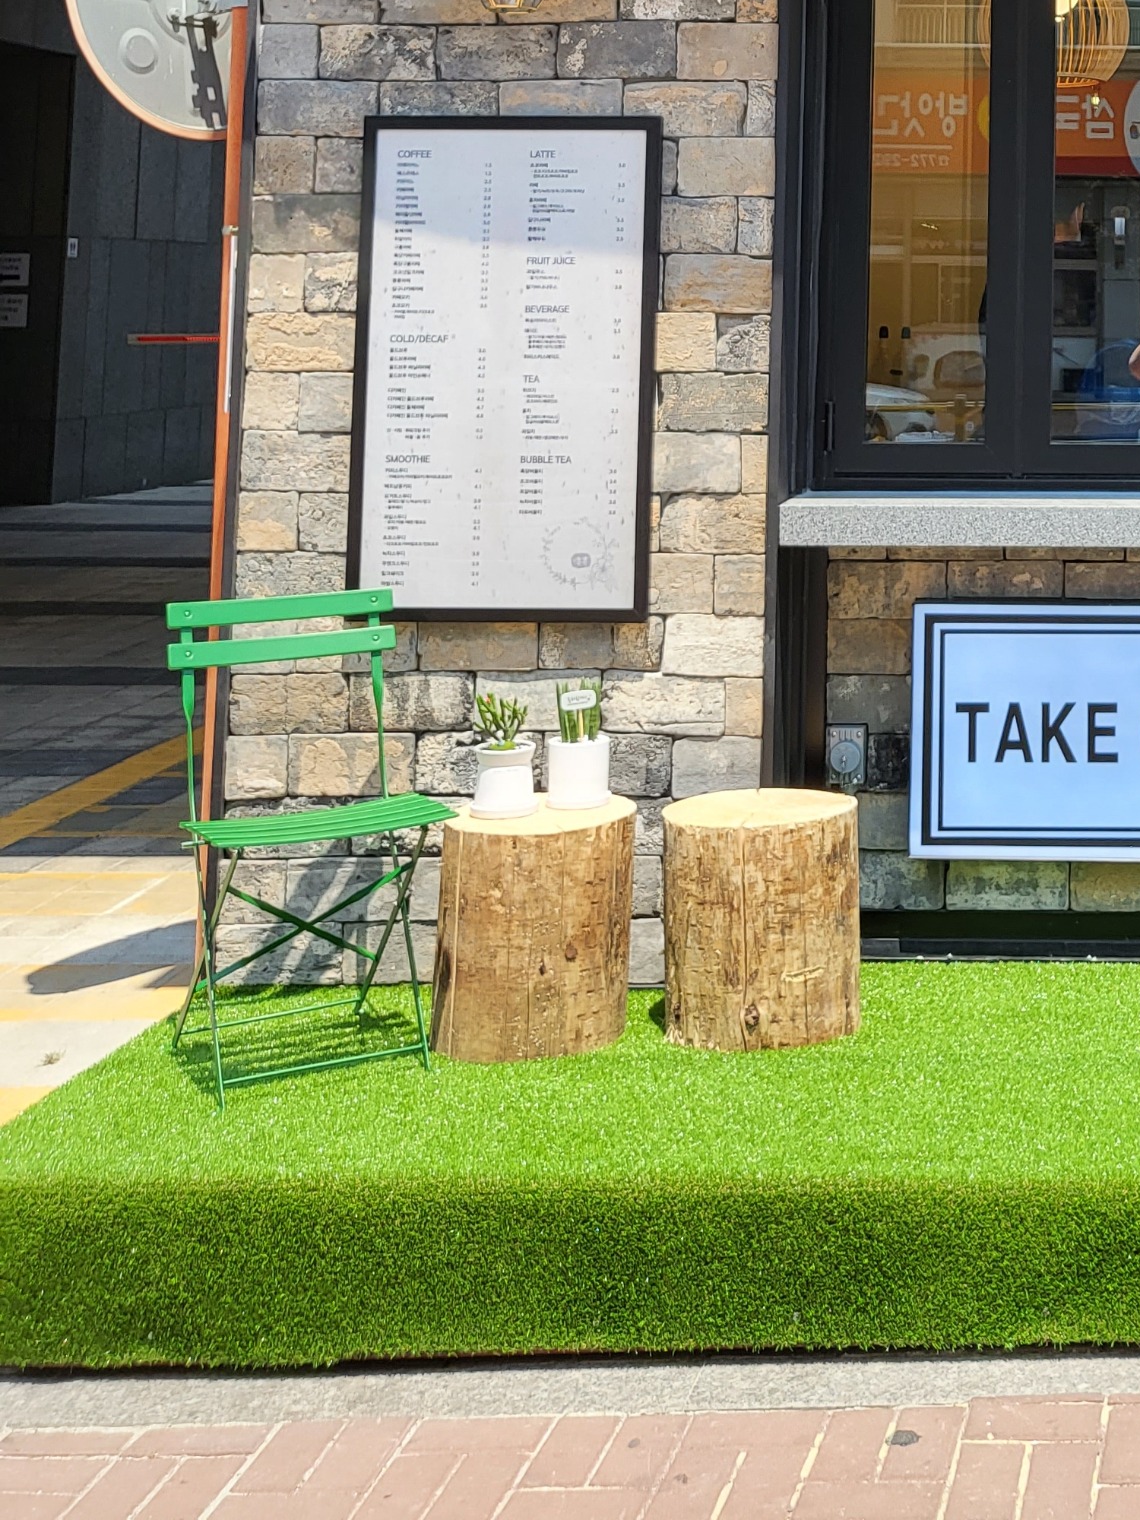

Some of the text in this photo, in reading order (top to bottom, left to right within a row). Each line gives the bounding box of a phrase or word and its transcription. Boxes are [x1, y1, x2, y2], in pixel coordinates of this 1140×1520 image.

[397, 149, 433, 159] COFFEE
[529, 150, 556, 159] LATTE
[526, 256, 577, 265] FRUIT JUICE
[524, 305, 571, 314] BEVERAGE
[389, 334, 449, 343] COLD/DECAF
[522, 374, 540, 383] TEA
[384, 454, 431, 464] SMOOTHIE
[519, 455, 572, 464] BUBBLE TEA
[955, 701, 1119, 763] TAKE
